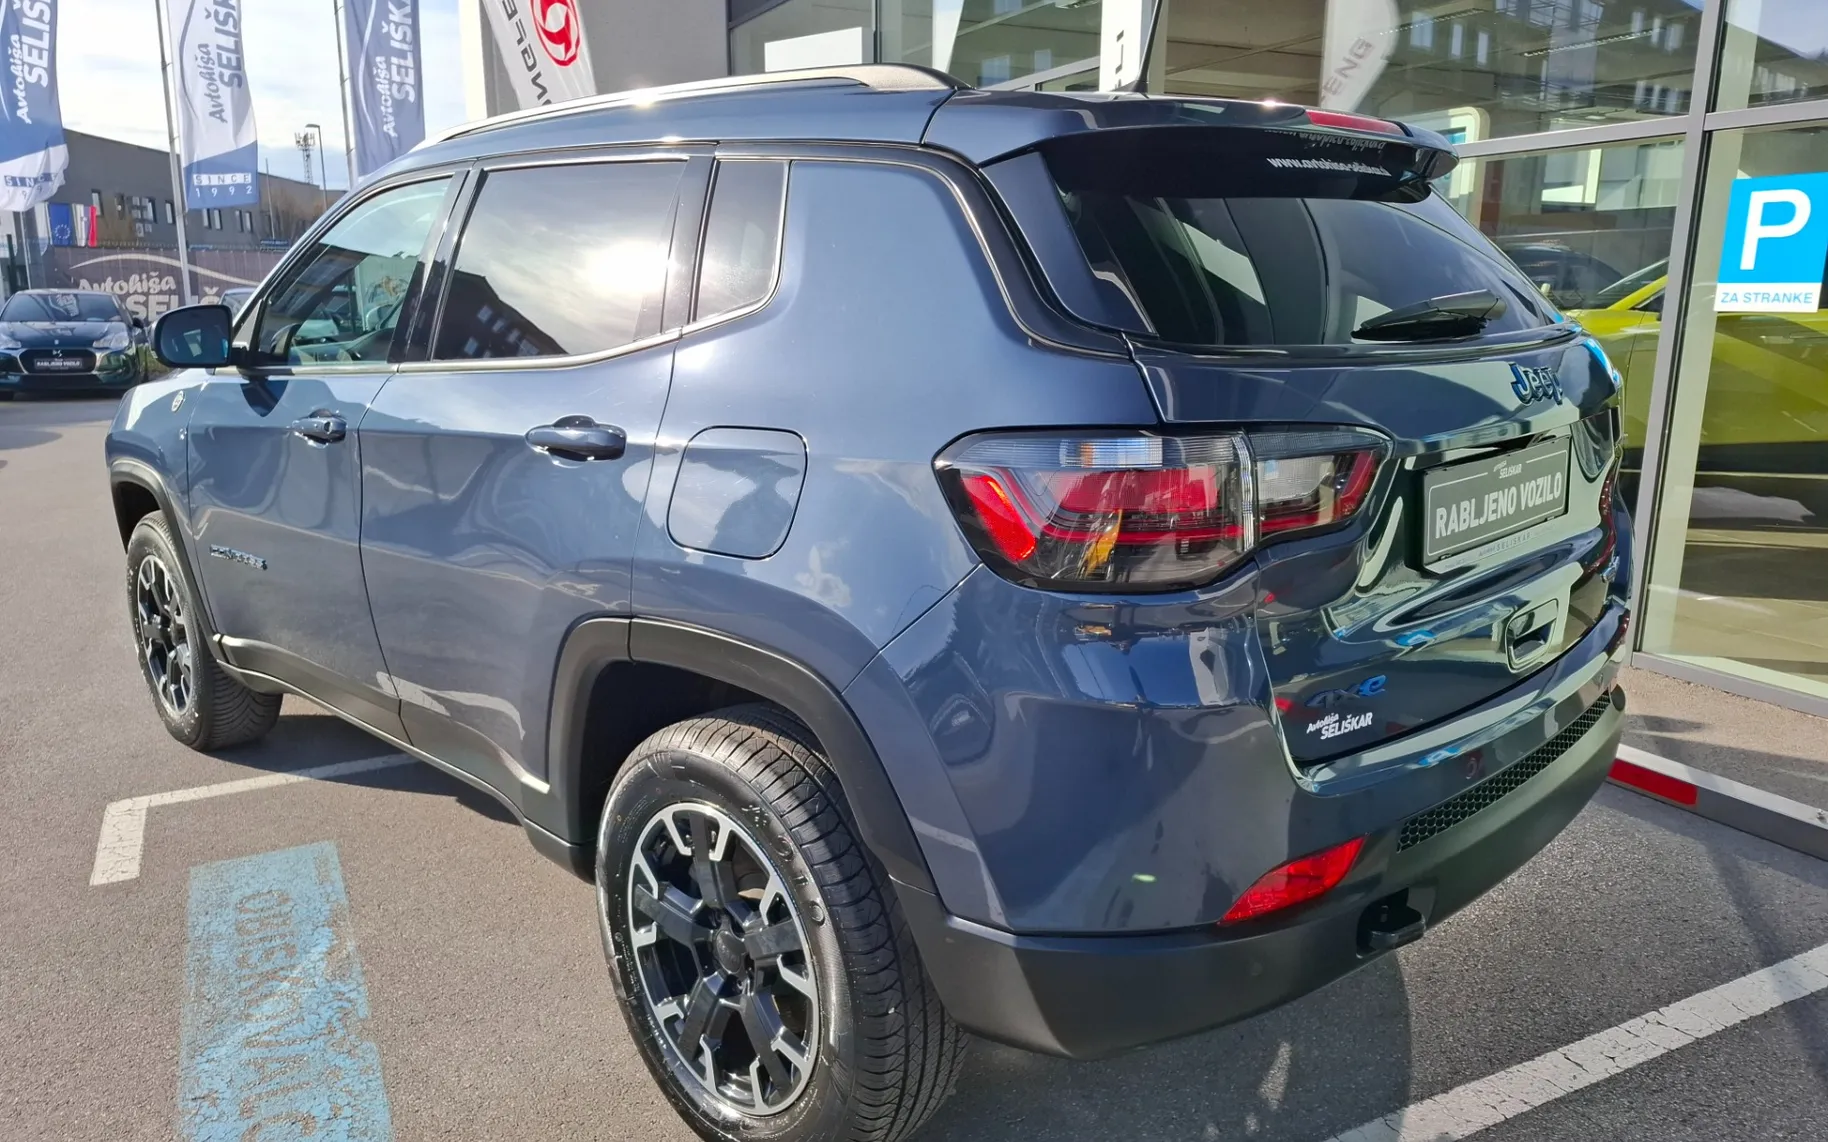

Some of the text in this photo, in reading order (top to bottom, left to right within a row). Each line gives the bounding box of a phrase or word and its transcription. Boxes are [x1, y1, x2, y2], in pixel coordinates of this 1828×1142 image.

[13, 0, 51, 88] SELIŠ
[382, 0, 415, 103] SELIŠK
[195, 43, 228, 124] Avtohiša
[195, 174, 250, 185] SINCE
[1740, 188, 1812, 271] P
[78, 271, 177, 295] Avtohiša
[1720, 292, 1814, 305] ZA STRANKE
[1508, 361, 1563, 406] Jeep
[1435, 471, 1562, 539] RABLJENO VOZILO
[1320, 711, 1373, 740] SELIŠKAR
